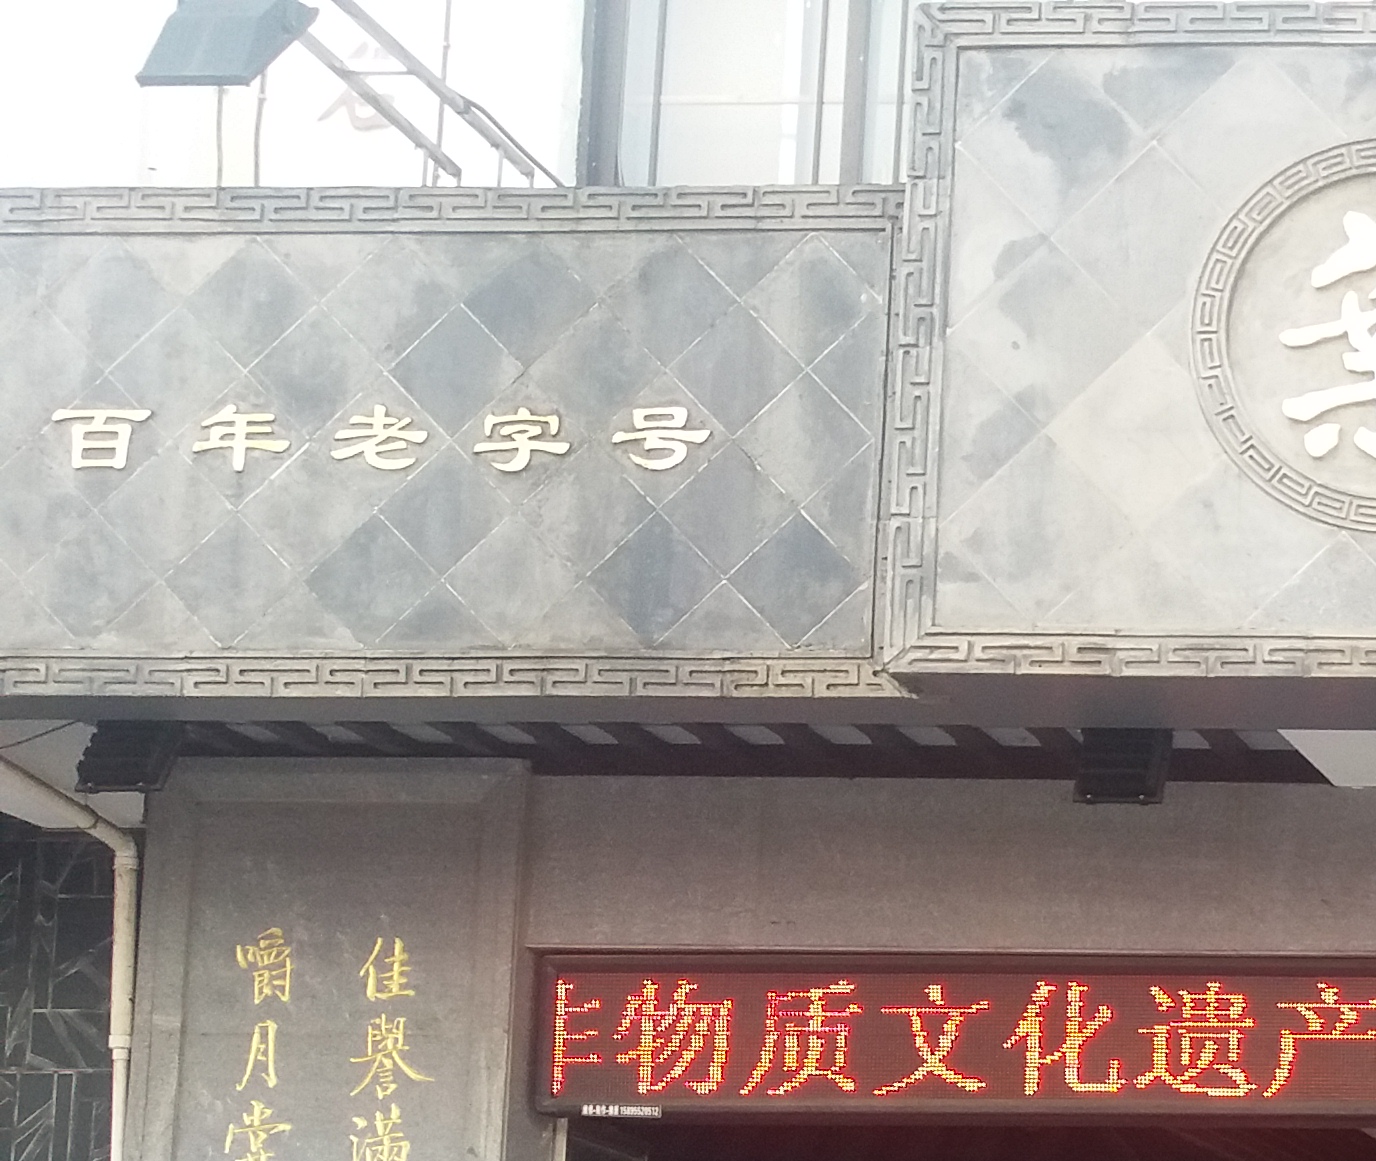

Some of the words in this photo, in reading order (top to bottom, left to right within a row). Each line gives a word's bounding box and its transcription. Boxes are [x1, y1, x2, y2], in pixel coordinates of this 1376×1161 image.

[51, 403, 713, 474] 百年老字号
